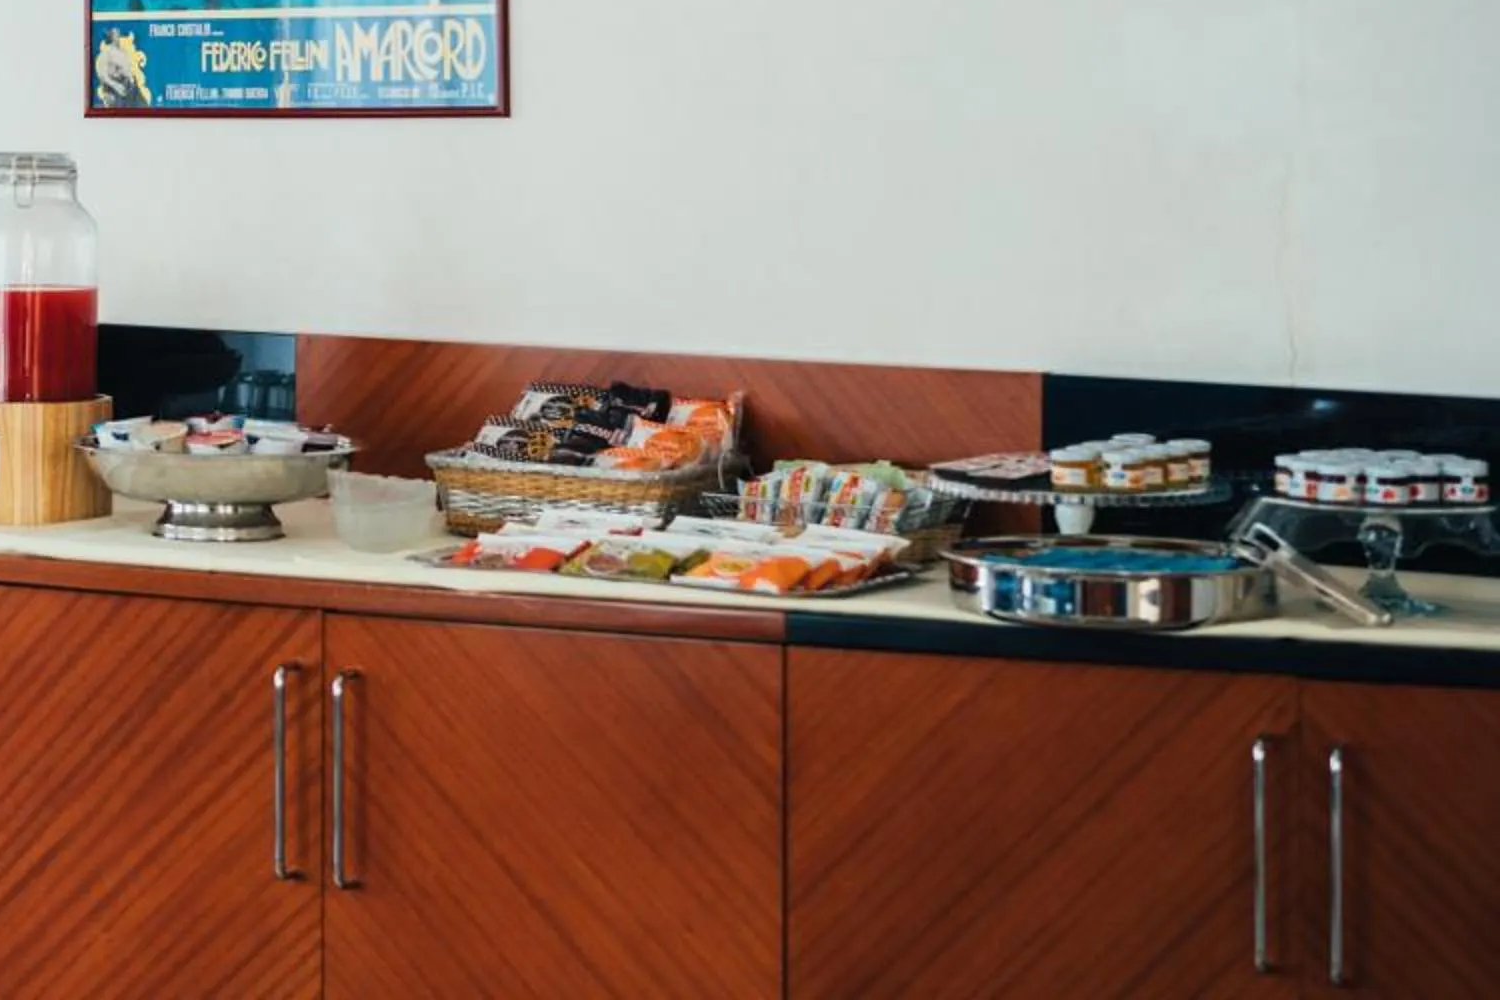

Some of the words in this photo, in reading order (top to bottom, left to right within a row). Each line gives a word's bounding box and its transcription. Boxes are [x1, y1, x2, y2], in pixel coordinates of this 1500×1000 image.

[202, 40, 267, 73] FEDERICO
[269, 39, 329, 72] FELLINI
[335, 18, 487, 83] AMARCORD
